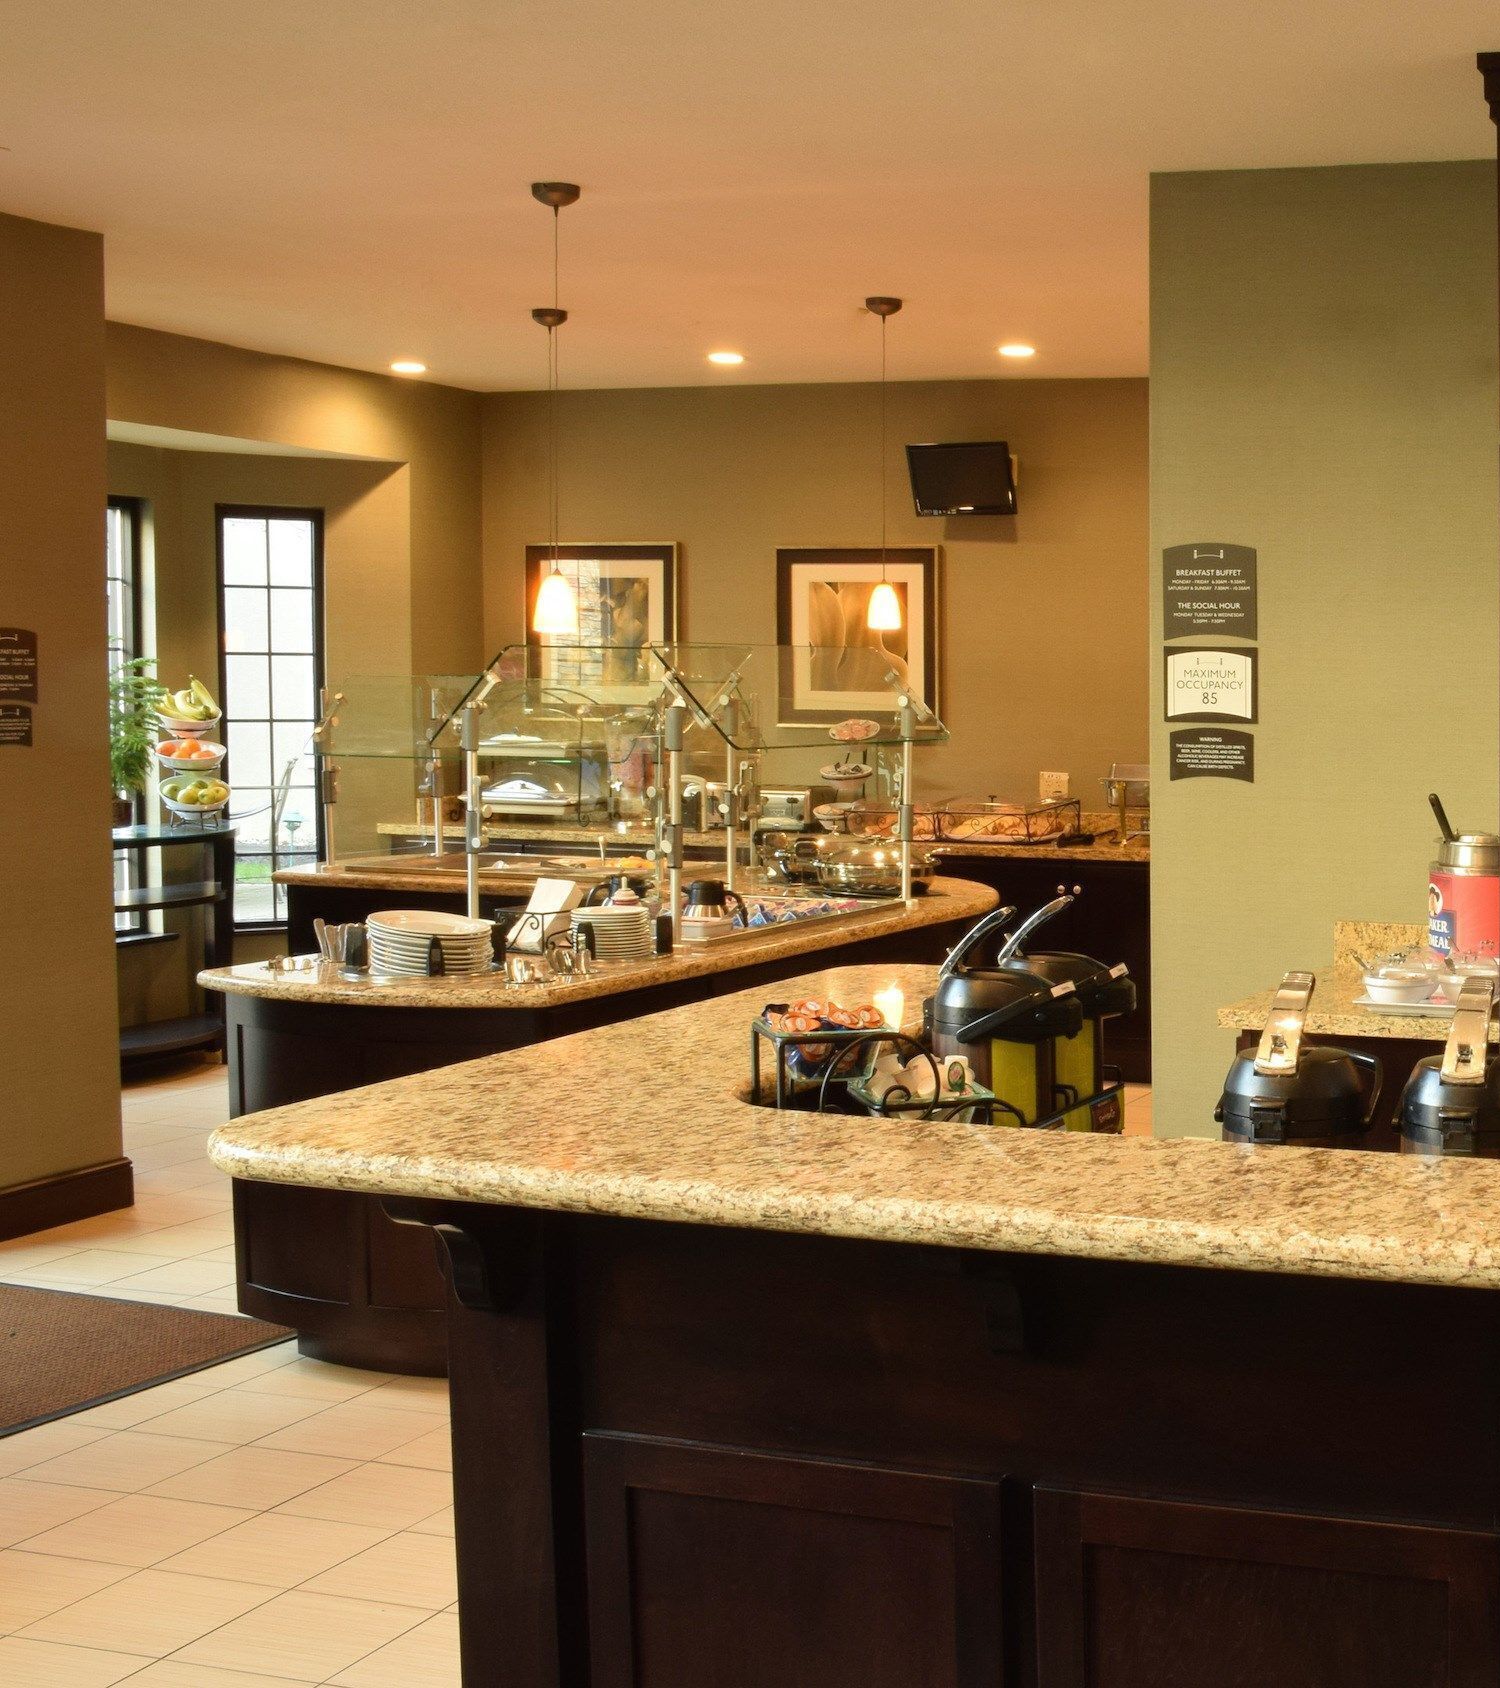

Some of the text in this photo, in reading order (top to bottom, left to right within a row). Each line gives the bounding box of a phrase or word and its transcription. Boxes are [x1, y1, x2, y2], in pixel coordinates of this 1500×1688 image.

[1183, 669, 1236, 678] MAXIMUM
[1176, 680, 1243, 690] OCCUPANCY
[1202, 692, 1218, 704] 85
